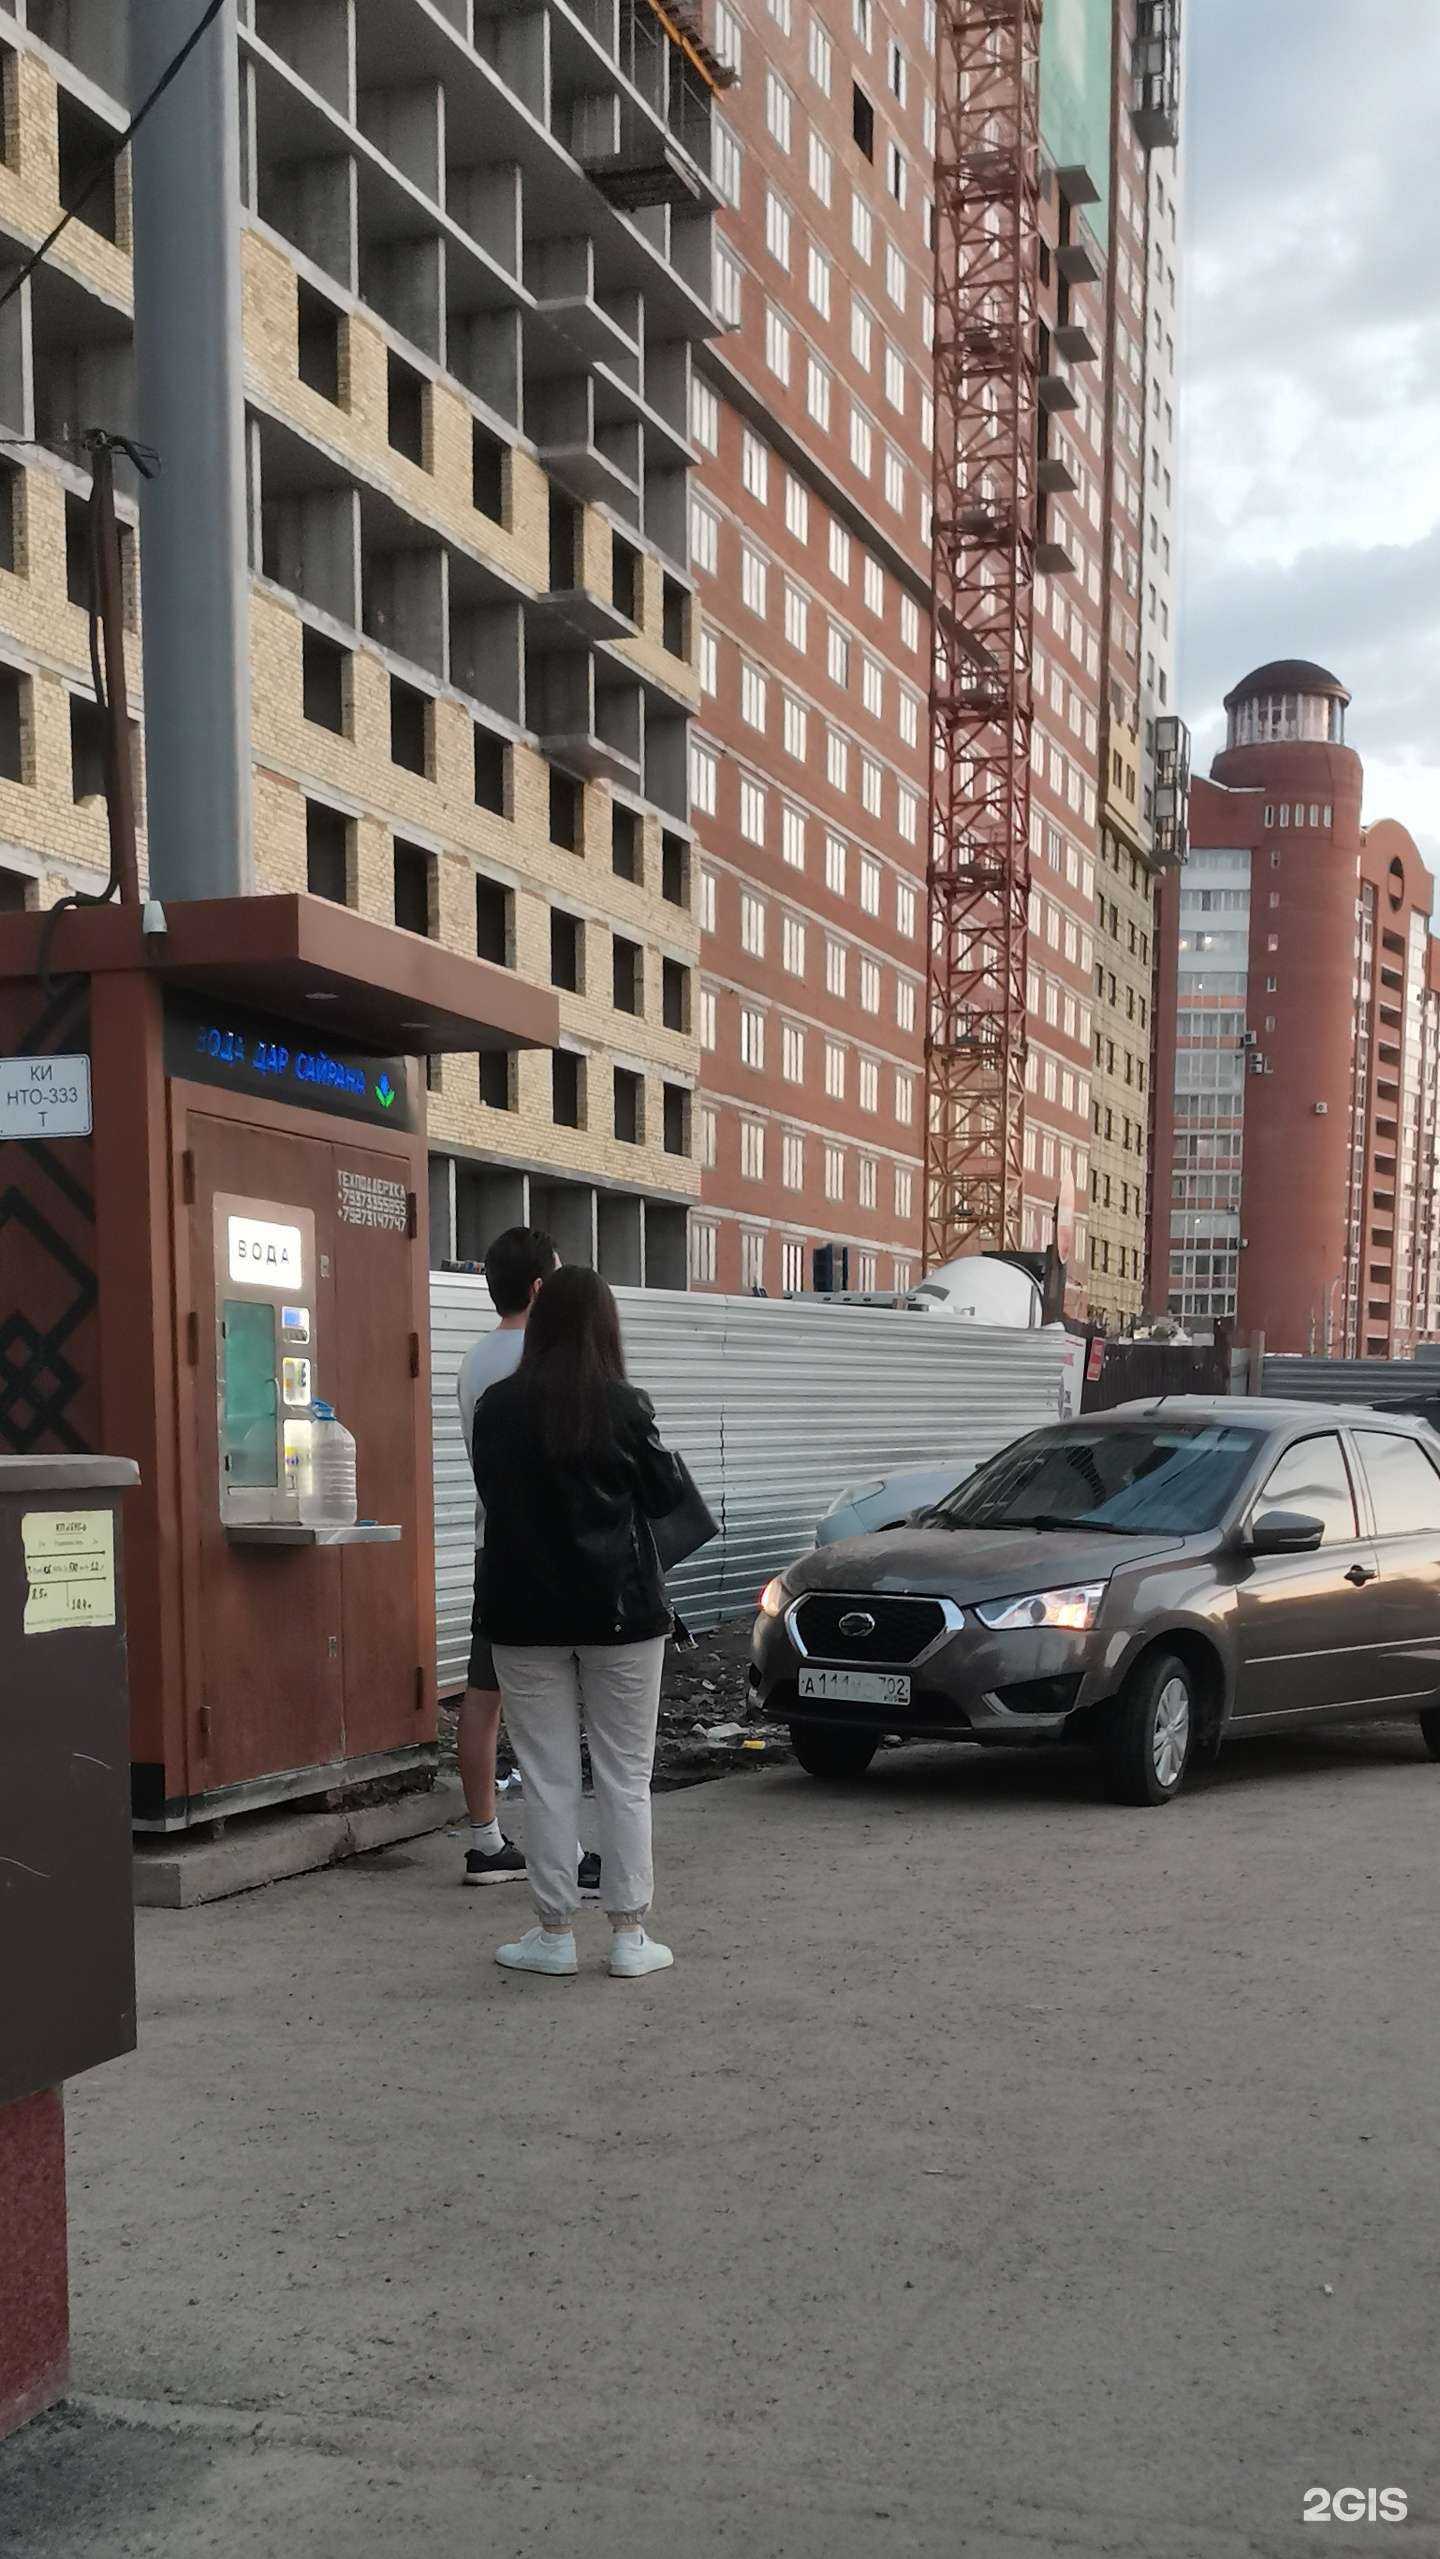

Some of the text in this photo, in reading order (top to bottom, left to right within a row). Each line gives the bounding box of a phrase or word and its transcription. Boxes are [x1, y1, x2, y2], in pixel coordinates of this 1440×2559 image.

[30, 1064, 53, 1081] КИ
[7, 1087, 79, 1105] НТО-333
[237, 1239, 290, 1266] ВОДА
